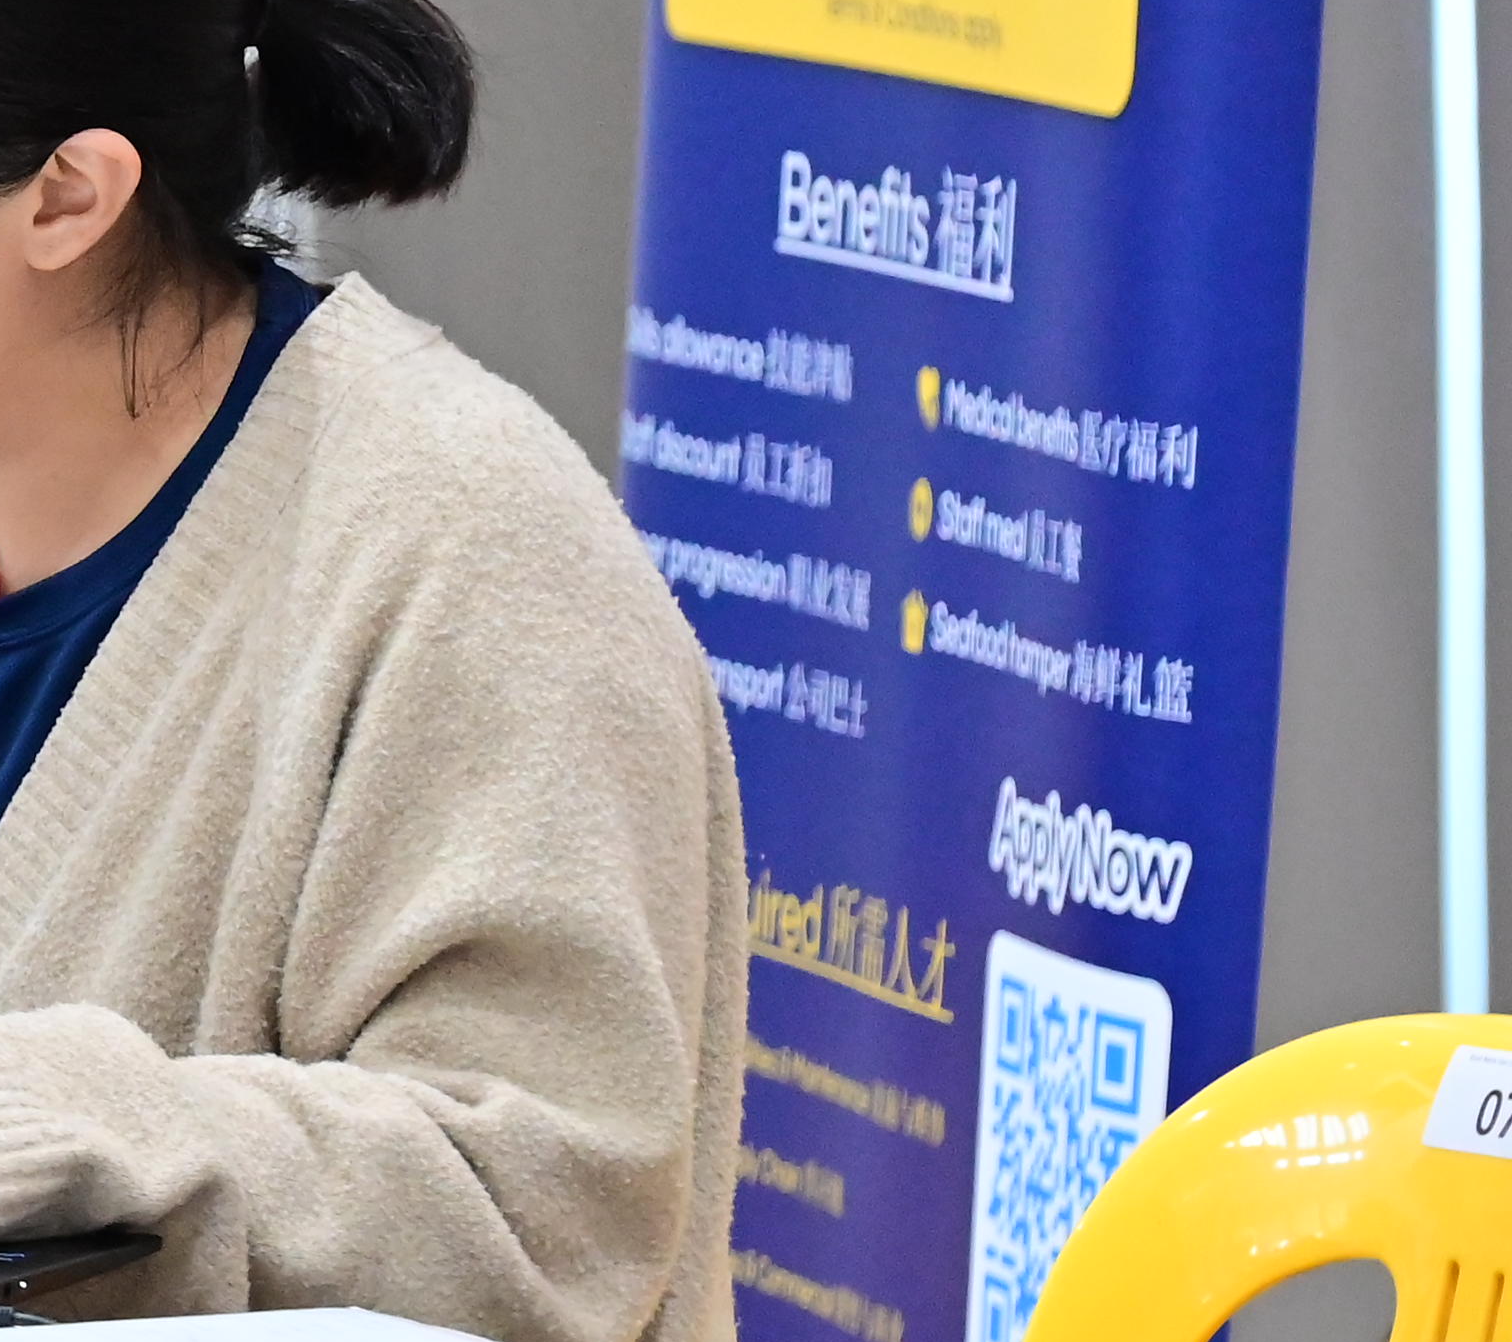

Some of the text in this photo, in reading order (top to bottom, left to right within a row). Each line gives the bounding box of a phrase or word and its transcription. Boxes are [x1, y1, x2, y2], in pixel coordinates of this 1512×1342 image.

[776, 149, 1017, 289] Benefits 福利
[654, 419, 740, 485] discount
[943, 378, 1198, 490] Medical benefits 医疗福利
[936, 490, 985, 548] Staff
[665, 538, 787, 602] progression
[929, 600, 1009, 671] Seafood
[749, 869, 956, 1011] uired 所需人才
